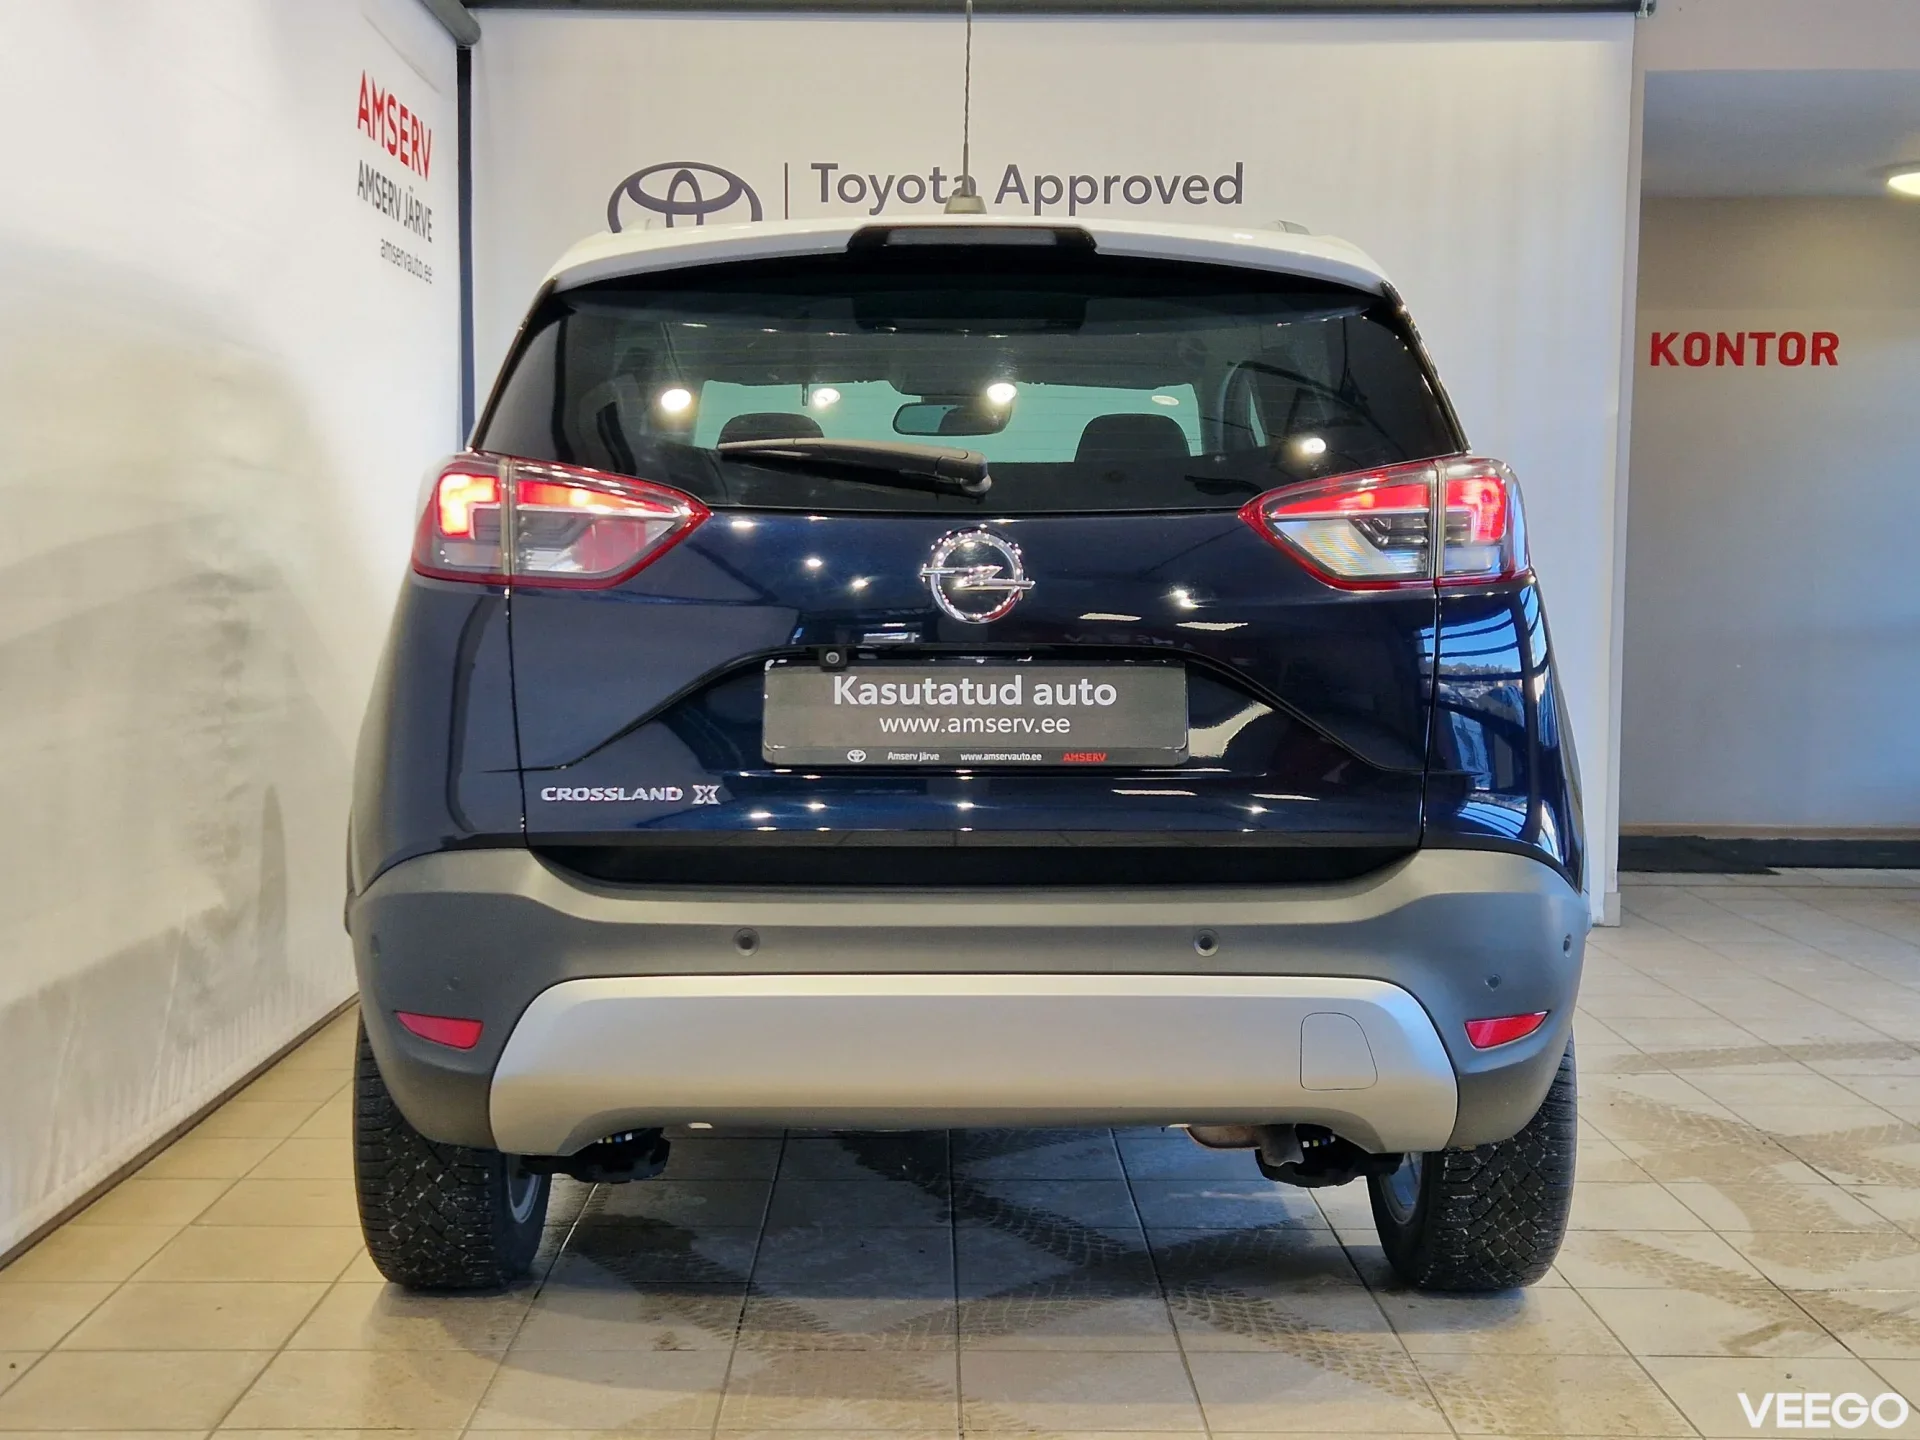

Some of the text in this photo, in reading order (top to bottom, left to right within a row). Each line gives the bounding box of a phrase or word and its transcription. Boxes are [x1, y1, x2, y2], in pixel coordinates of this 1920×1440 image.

[357, 69, 432, 182] AMSERV
[357, 159, 433, 243] AMSERV JÄRVE
[810, 162, 1244, 215] Toyota Approved
[380, 238, 433, 285] amservauto.ee
[1650, 331, 1840, 367] KONTOR
[832, 675, 1118, 706] Kasutatud auto
[879, 715, 1071, 734] www.amserv.ee
[887, 751, 1106, 764] Amserv Järve www.amservauto.ee AMSERV
[541, 784, 721, 805] CROSSLAND X
